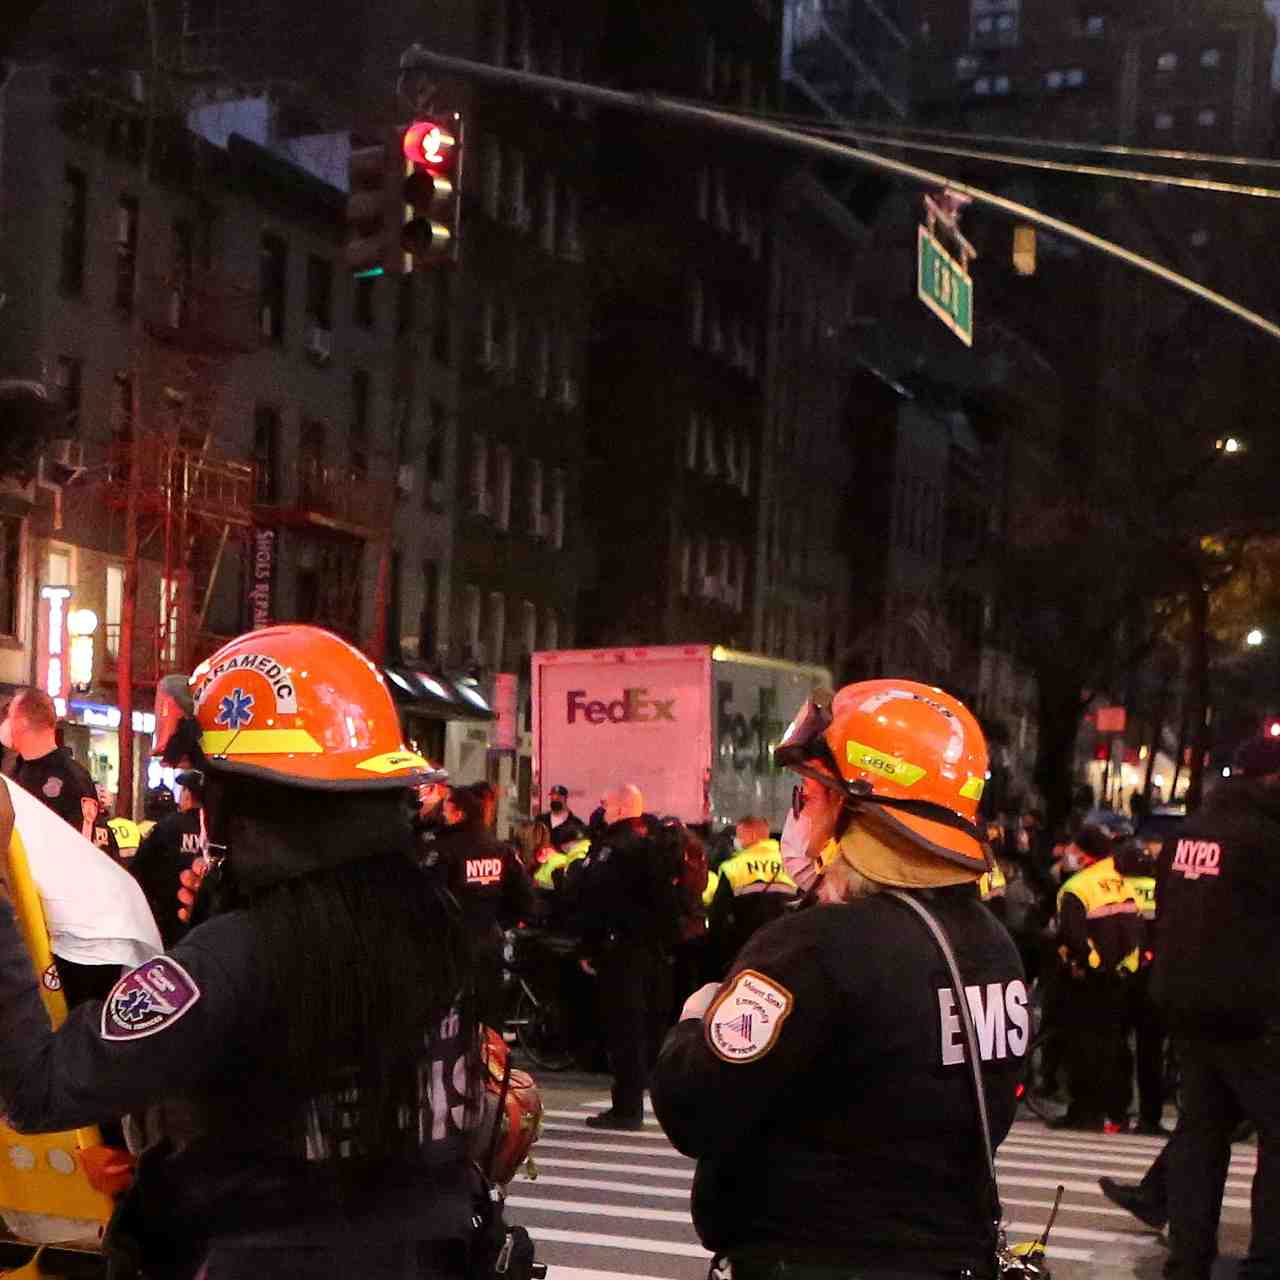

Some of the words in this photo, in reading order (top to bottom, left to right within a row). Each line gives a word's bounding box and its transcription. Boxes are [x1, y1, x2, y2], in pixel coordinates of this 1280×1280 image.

[566, 688, 676, 725] FedEx
[465, 858, 502, 877] NYPD
[1173, 839, 1222, 866] NYPD
[937, 978, 1030, 1067] EMS
